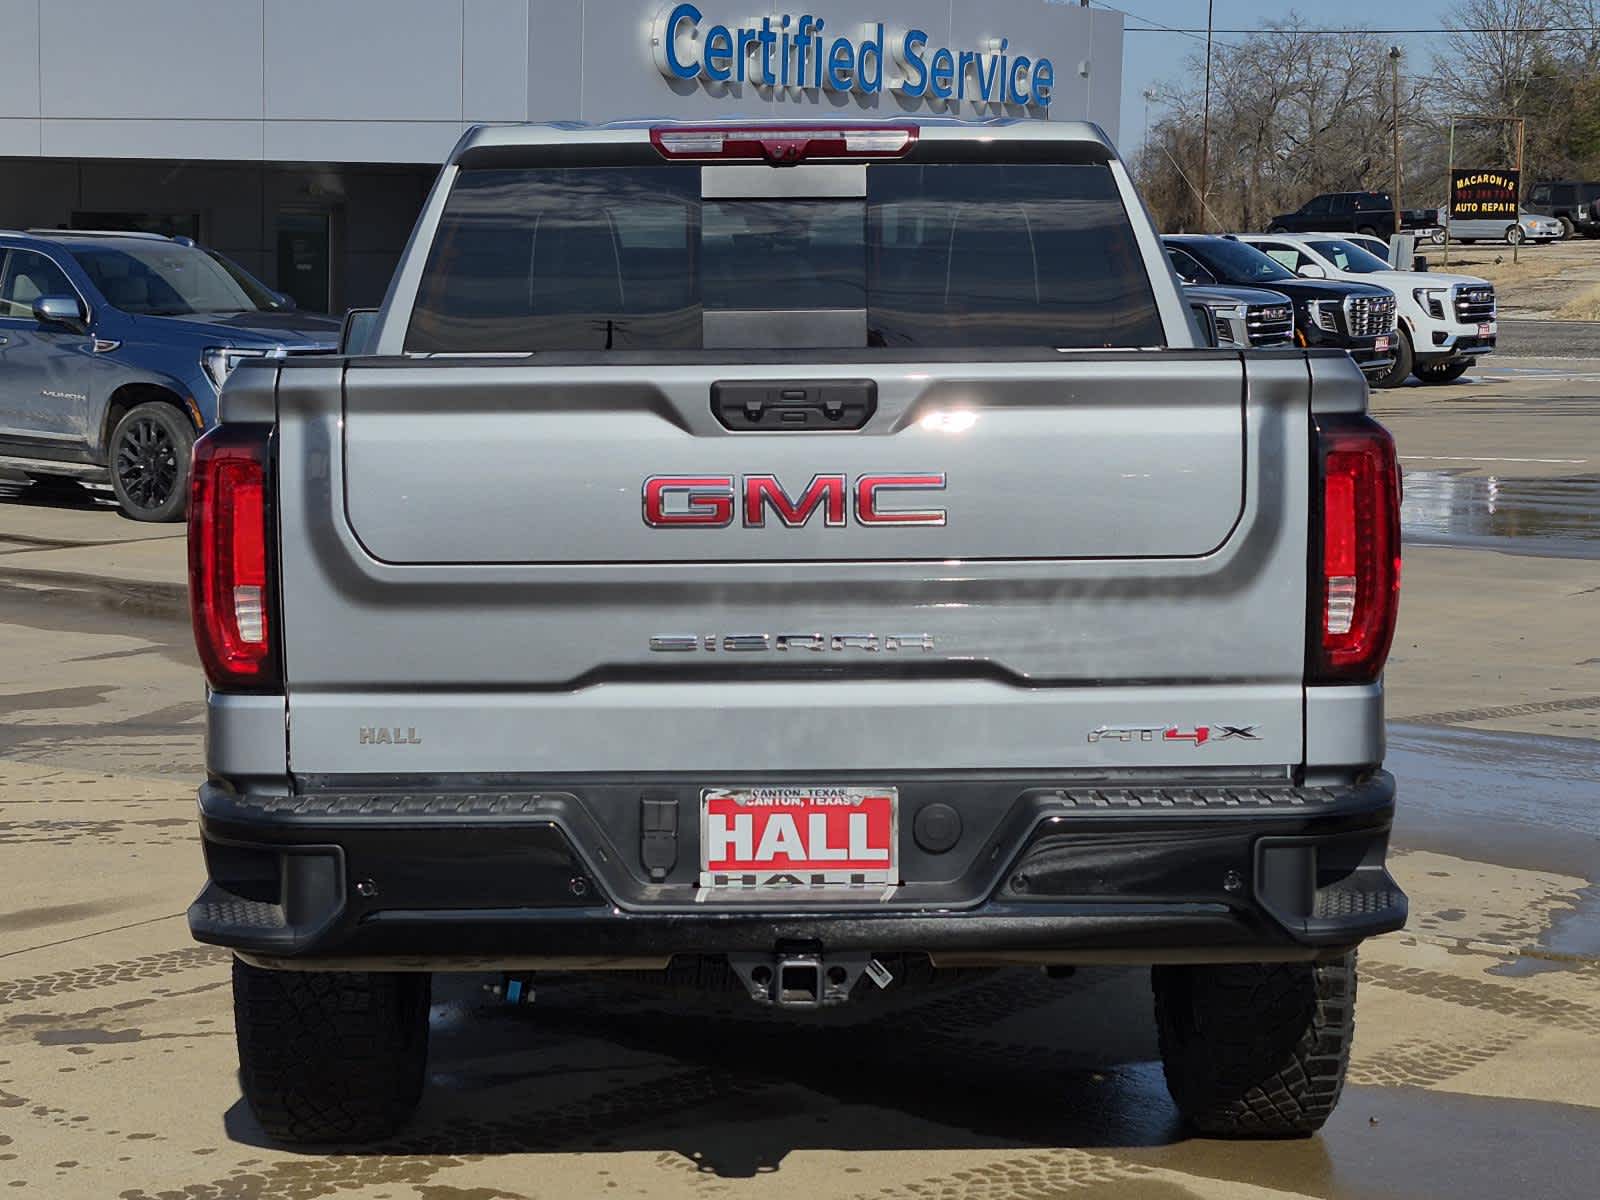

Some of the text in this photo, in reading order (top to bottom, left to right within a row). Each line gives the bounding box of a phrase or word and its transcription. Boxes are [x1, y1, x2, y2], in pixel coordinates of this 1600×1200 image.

[665, 3, 1055, 106] Certified Service
[1455, 203, 1515, 212] AUTO REPAIR
[641, 472, 947, 528] GMC
[650, 632, 936, 651] SIERRA
[359, 726, 422, 744] HALL
[1087, 723, 1264, 747] AT4X
[809, 796, 851, 807] TEXAS
[708, 813, 889, 861] HALL
